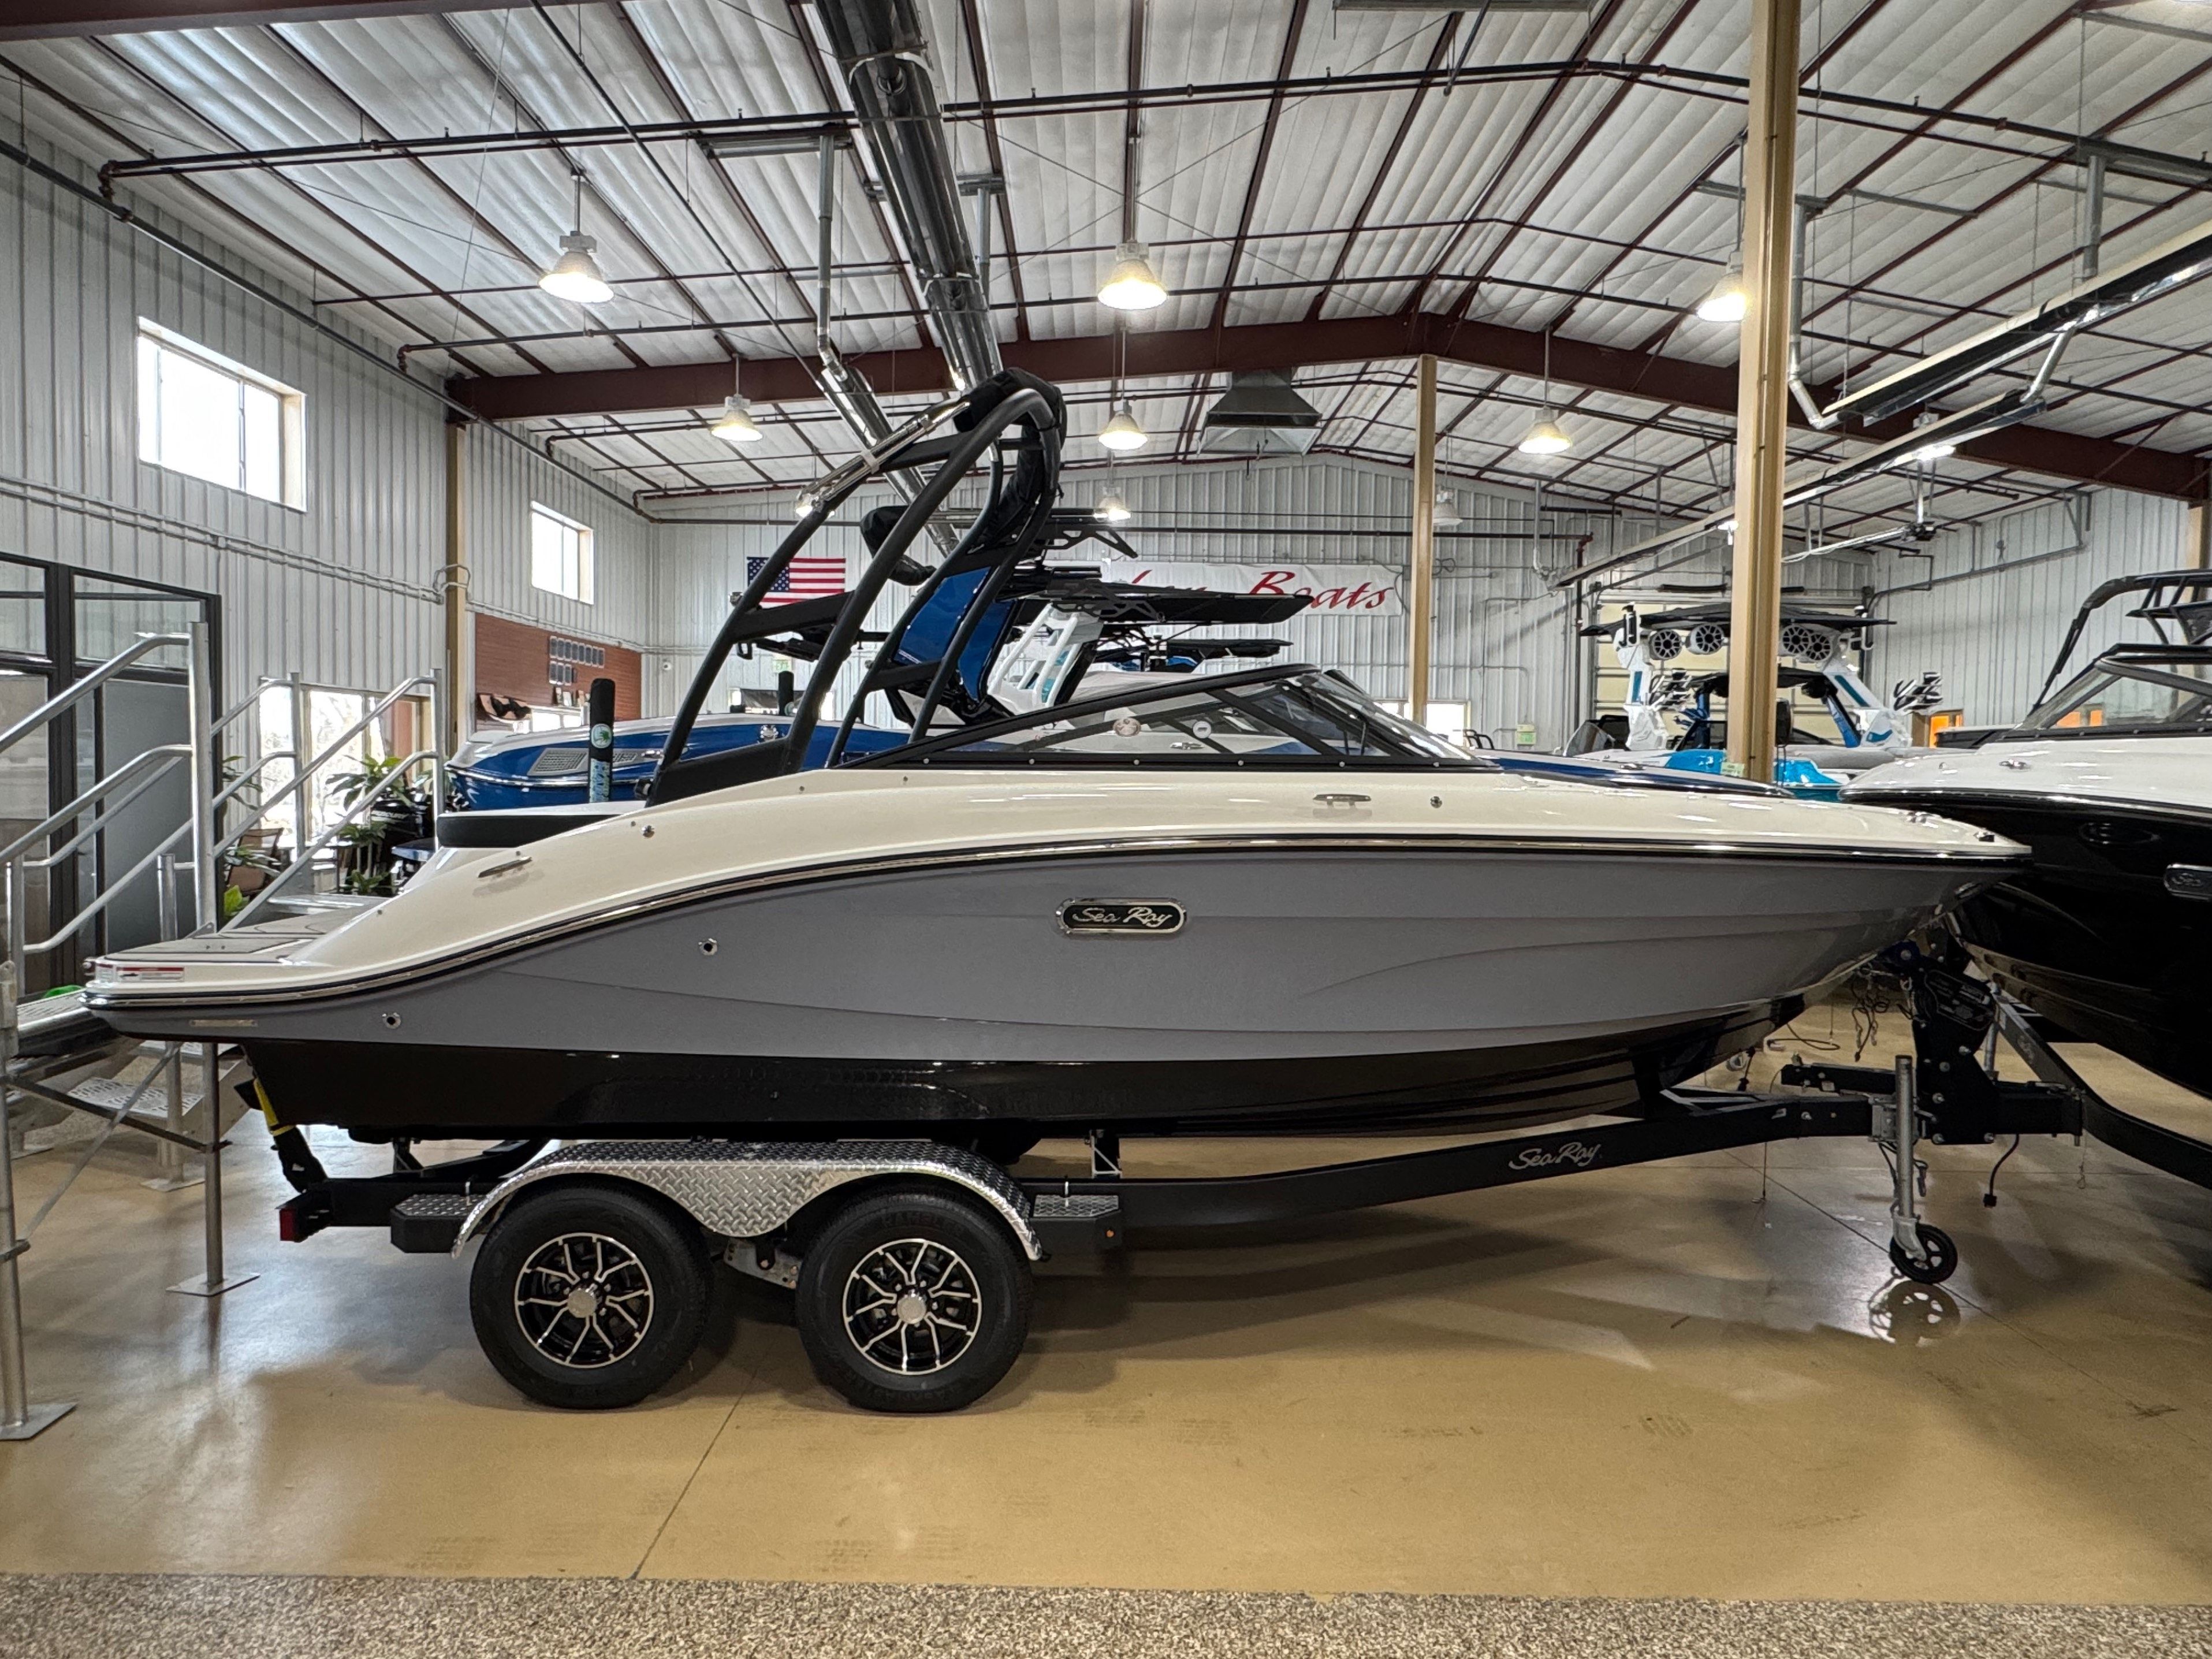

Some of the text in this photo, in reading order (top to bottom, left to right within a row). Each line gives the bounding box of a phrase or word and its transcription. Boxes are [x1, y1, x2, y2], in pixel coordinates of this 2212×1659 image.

[1072, 906, 1172, 928] Sea Ray
[1509, 1141, 1602, 1170] Sea Ray
